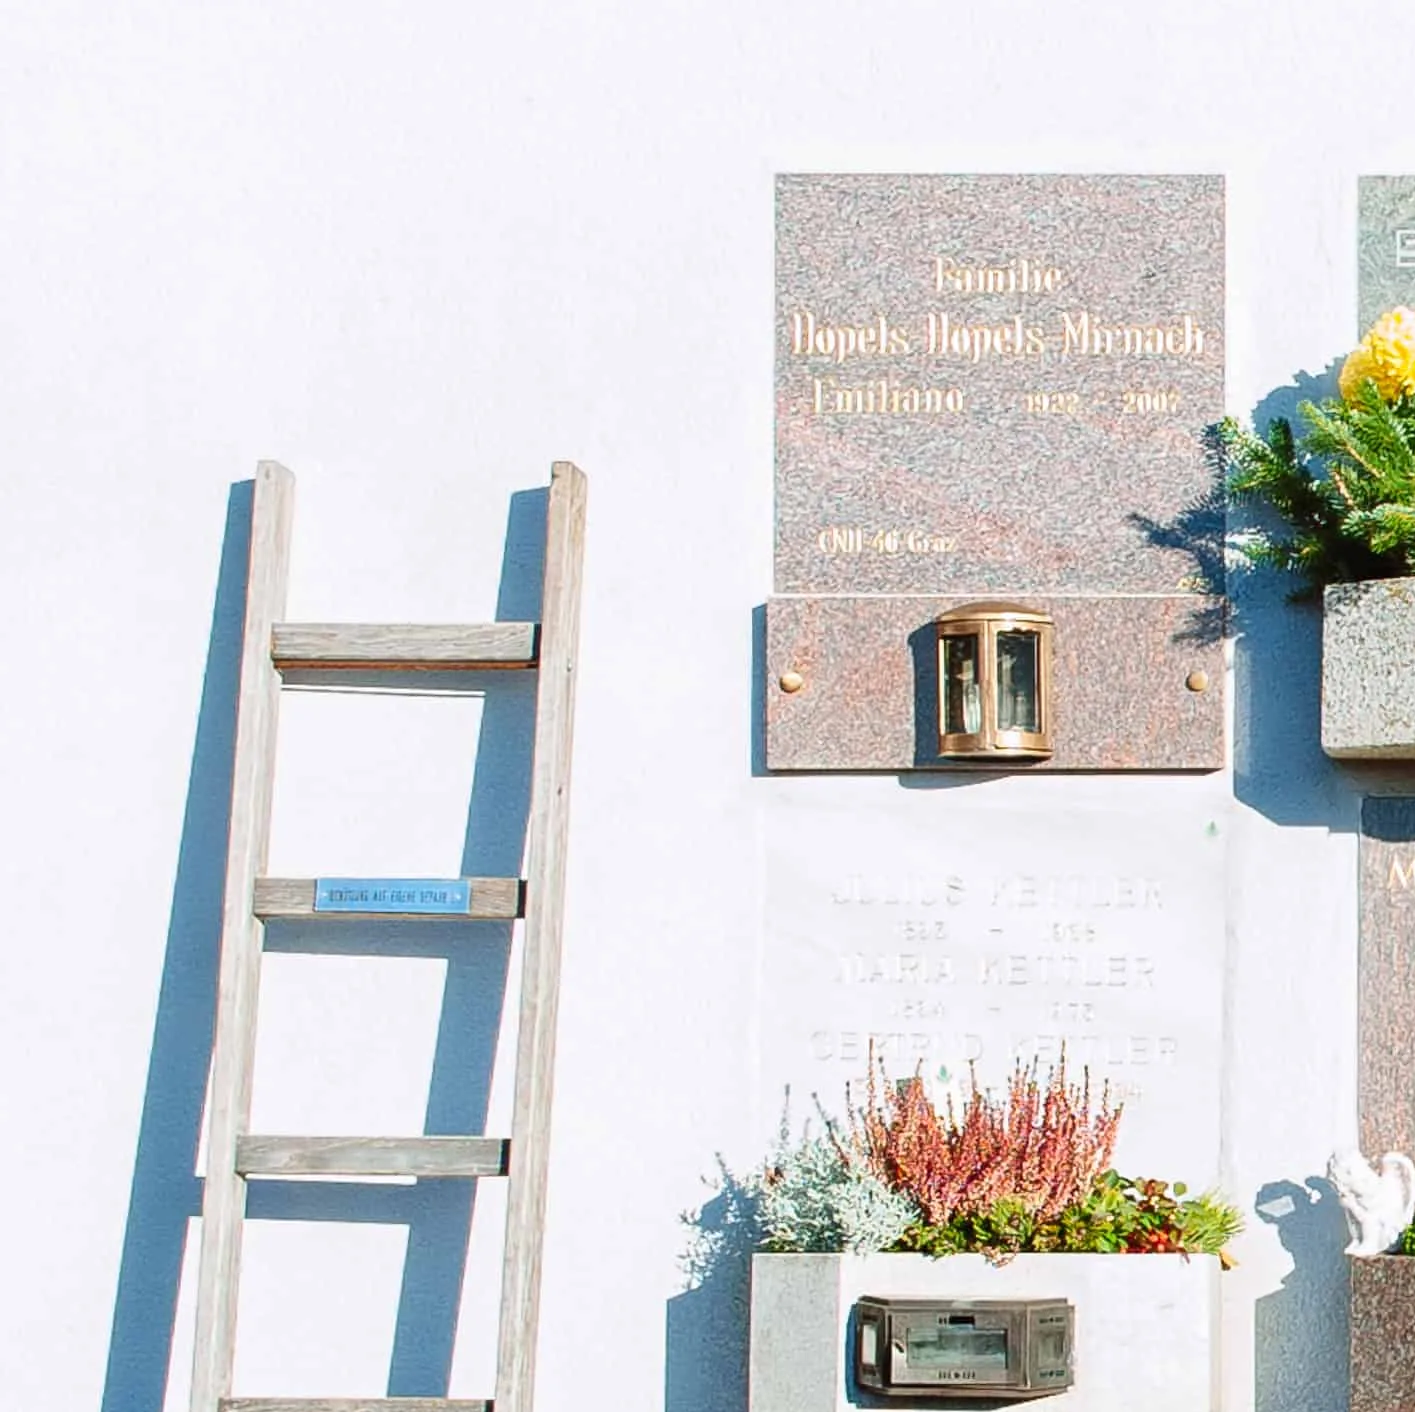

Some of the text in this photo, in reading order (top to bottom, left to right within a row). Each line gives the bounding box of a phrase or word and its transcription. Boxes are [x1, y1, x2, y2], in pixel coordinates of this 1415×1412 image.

[935, 257, 1063, 293] Familie
[812, 377, 964, 413] Emiliano
[834, 951, 1156, 989] MARIA KETTLER
